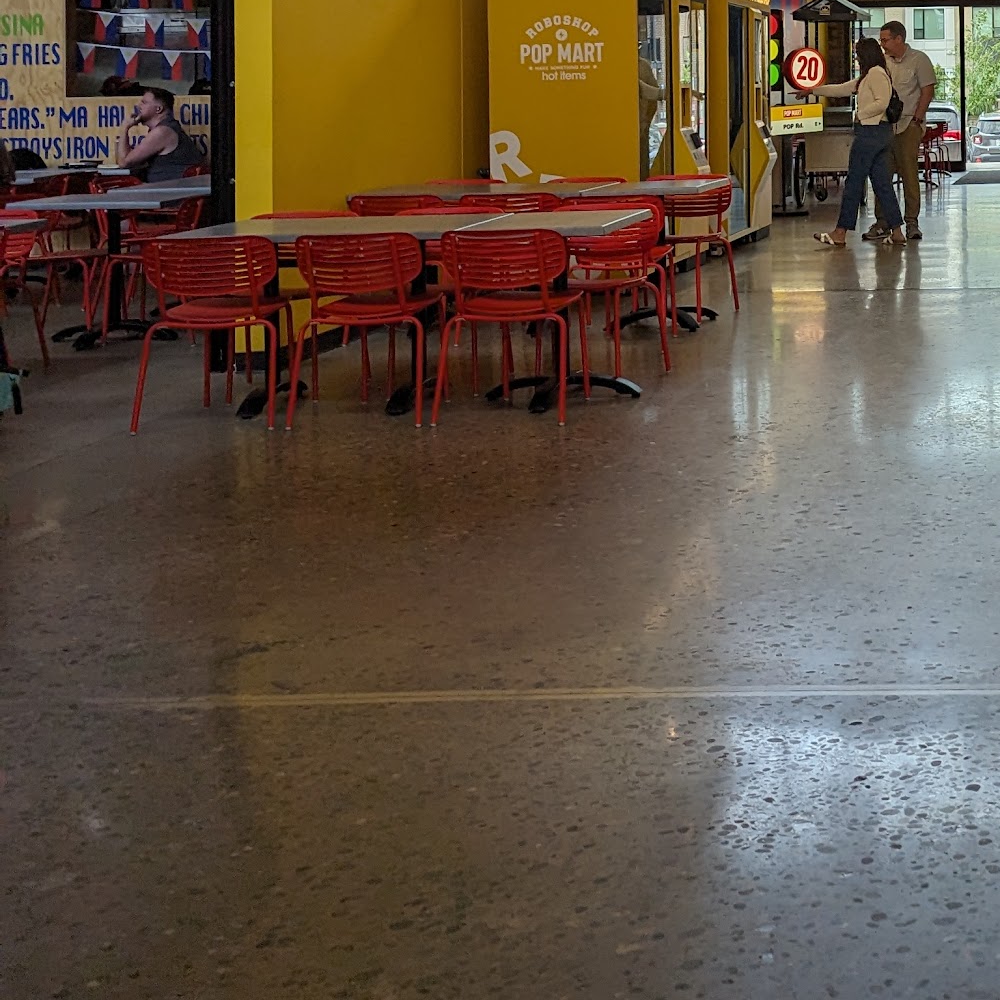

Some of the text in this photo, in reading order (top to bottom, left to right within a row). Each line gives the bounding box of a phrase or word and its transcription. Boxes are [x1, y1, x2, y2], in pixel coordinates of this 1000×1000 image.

[1, 12, 44, 37] SINA
[525, 15, 599, 39] ROBOSHOP
[12, 42, 60, 65] FRIES
[520, 42, 605, 65] POP MART
[541, 70, 587, 81] hot items
[796, 55, 819, 81] 20
[60, 106, 88, 129] MA
[67, 136, 109, 159] IRON
